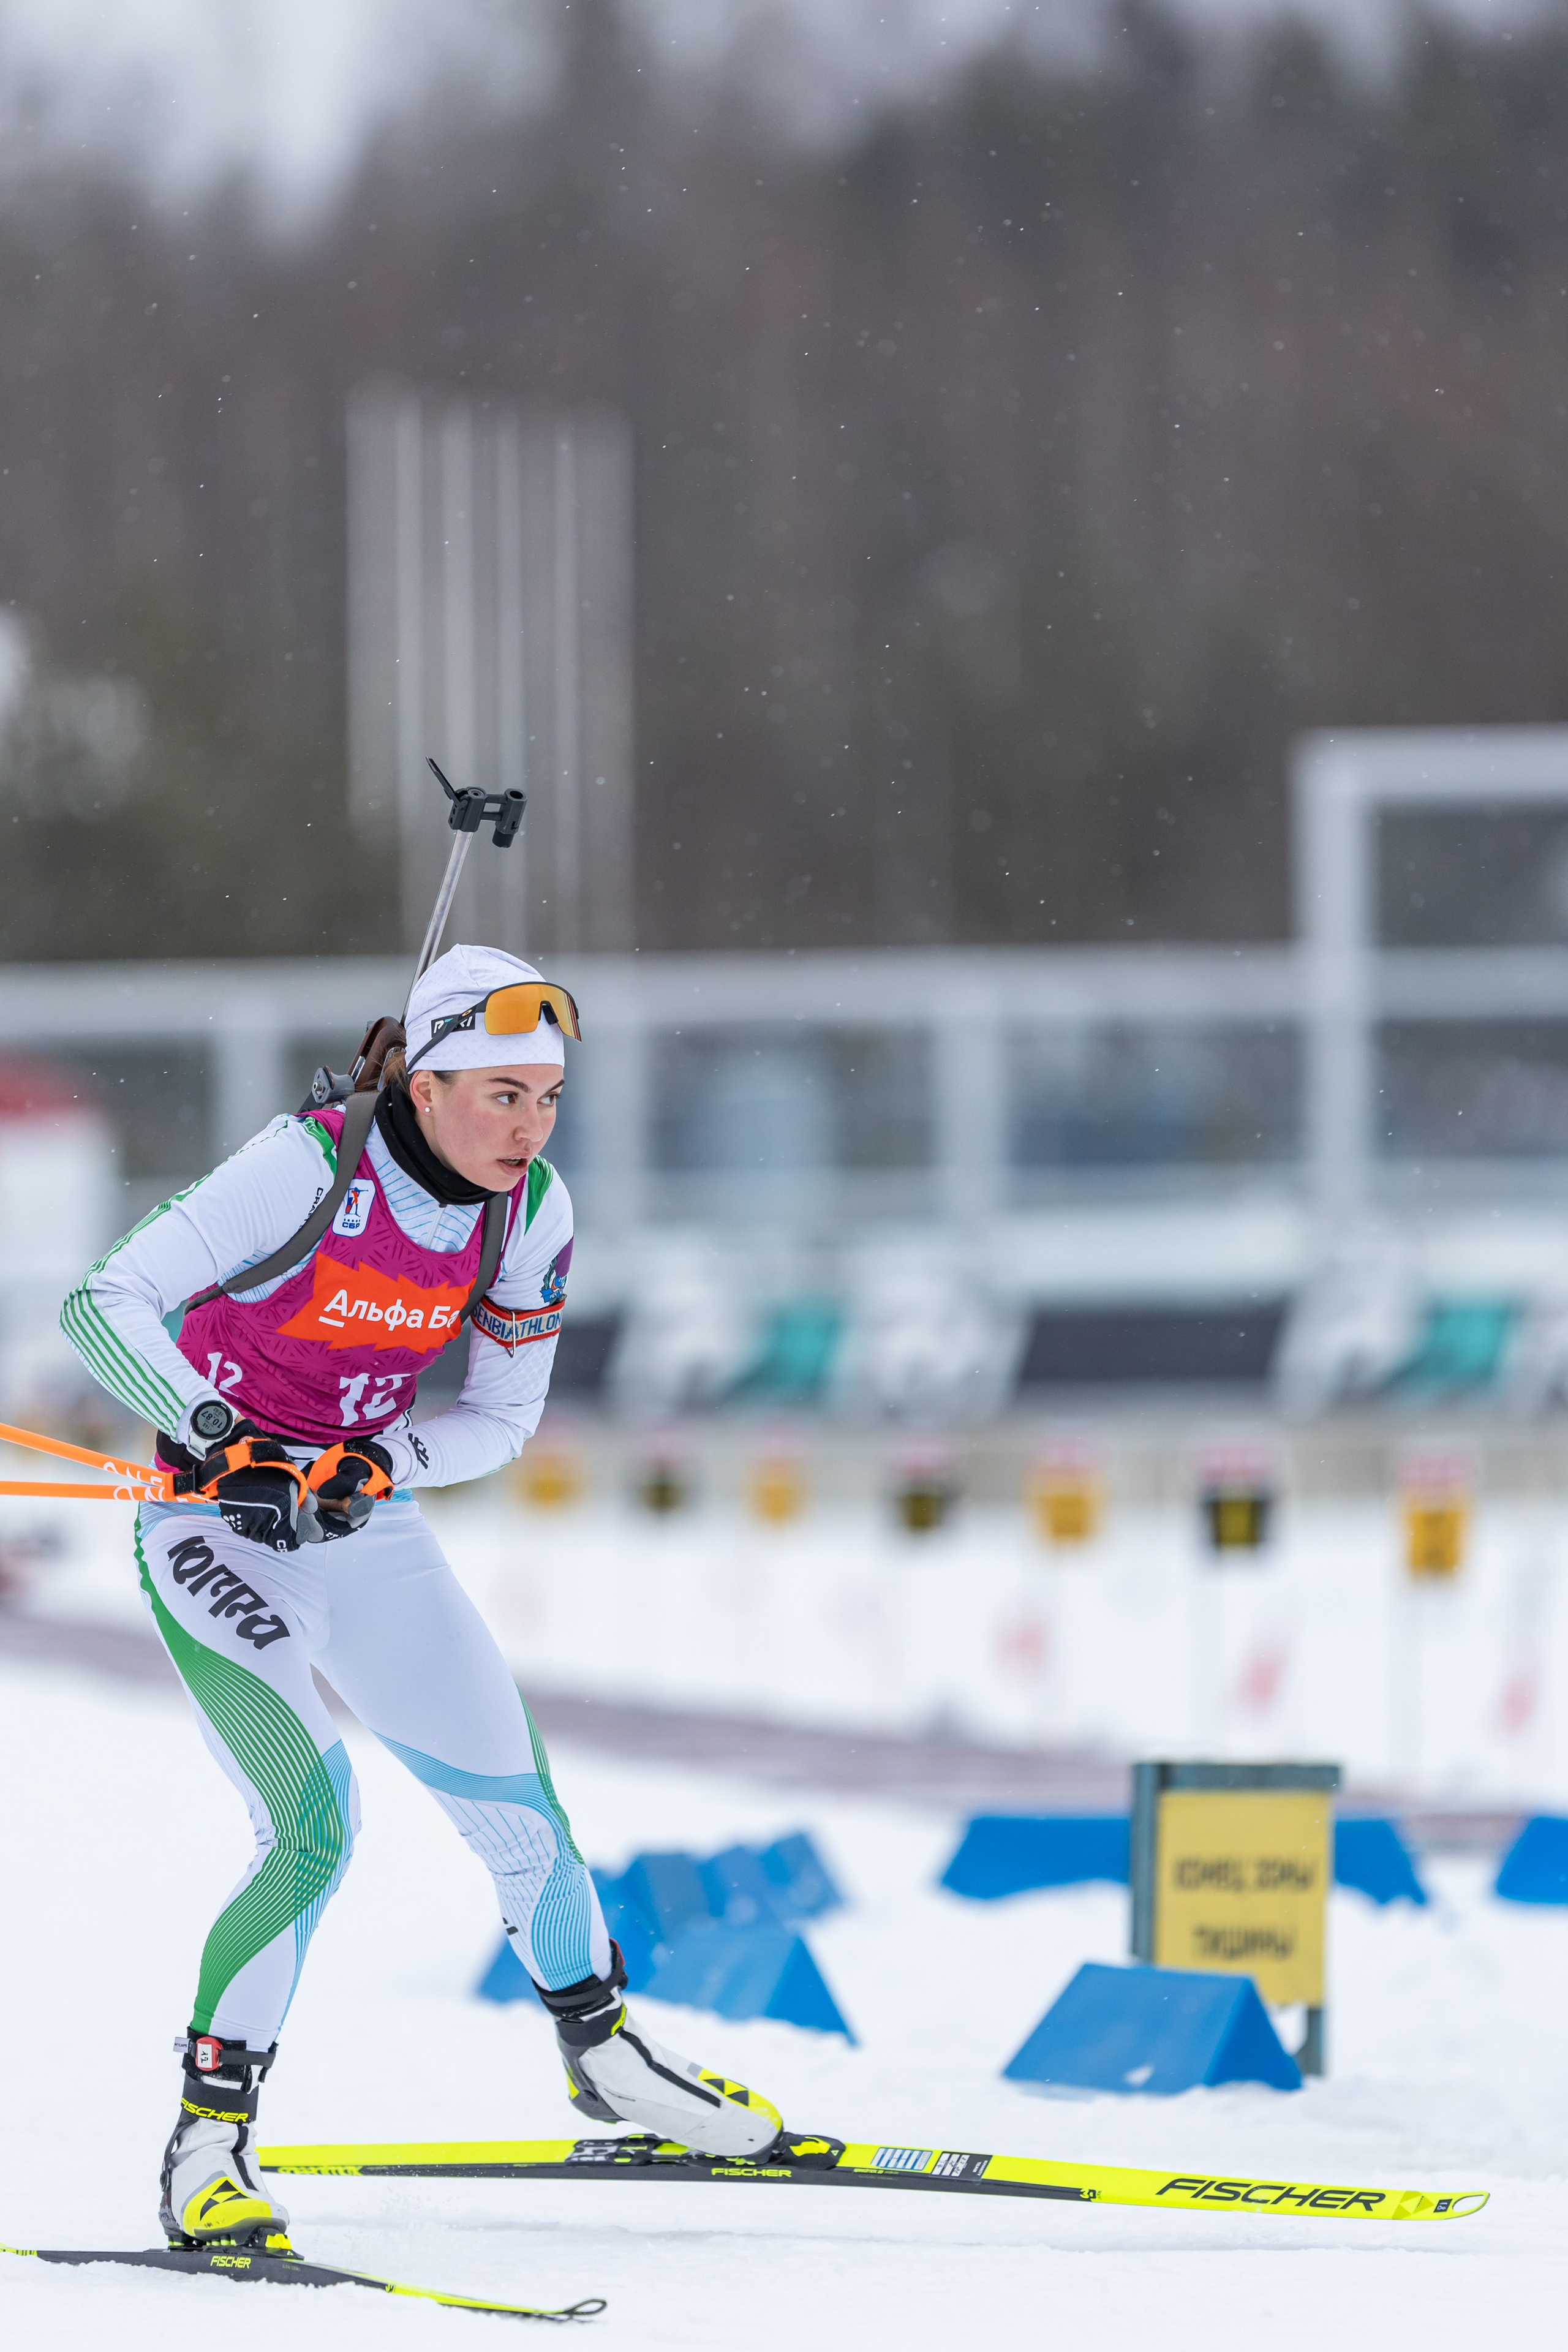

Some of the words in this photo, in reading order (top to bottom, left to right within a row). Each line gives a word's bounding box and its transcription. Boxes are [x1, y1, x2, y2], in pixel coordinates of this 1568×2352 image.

[318, 1289, 424, 1332] Альфа
[207, 1352, 243, 1398] 12
[339, 1373, 412, 1427] 12
[201, 1411, 223, 1428] 10.87
[181, 2097, 249, 2122] FISCHER
[711, 2168, 792, 2177] FISCHER
[1155, 2177, 1386, 2212] FISCHER
[210, 2255, 251, 2269] FISCHER
